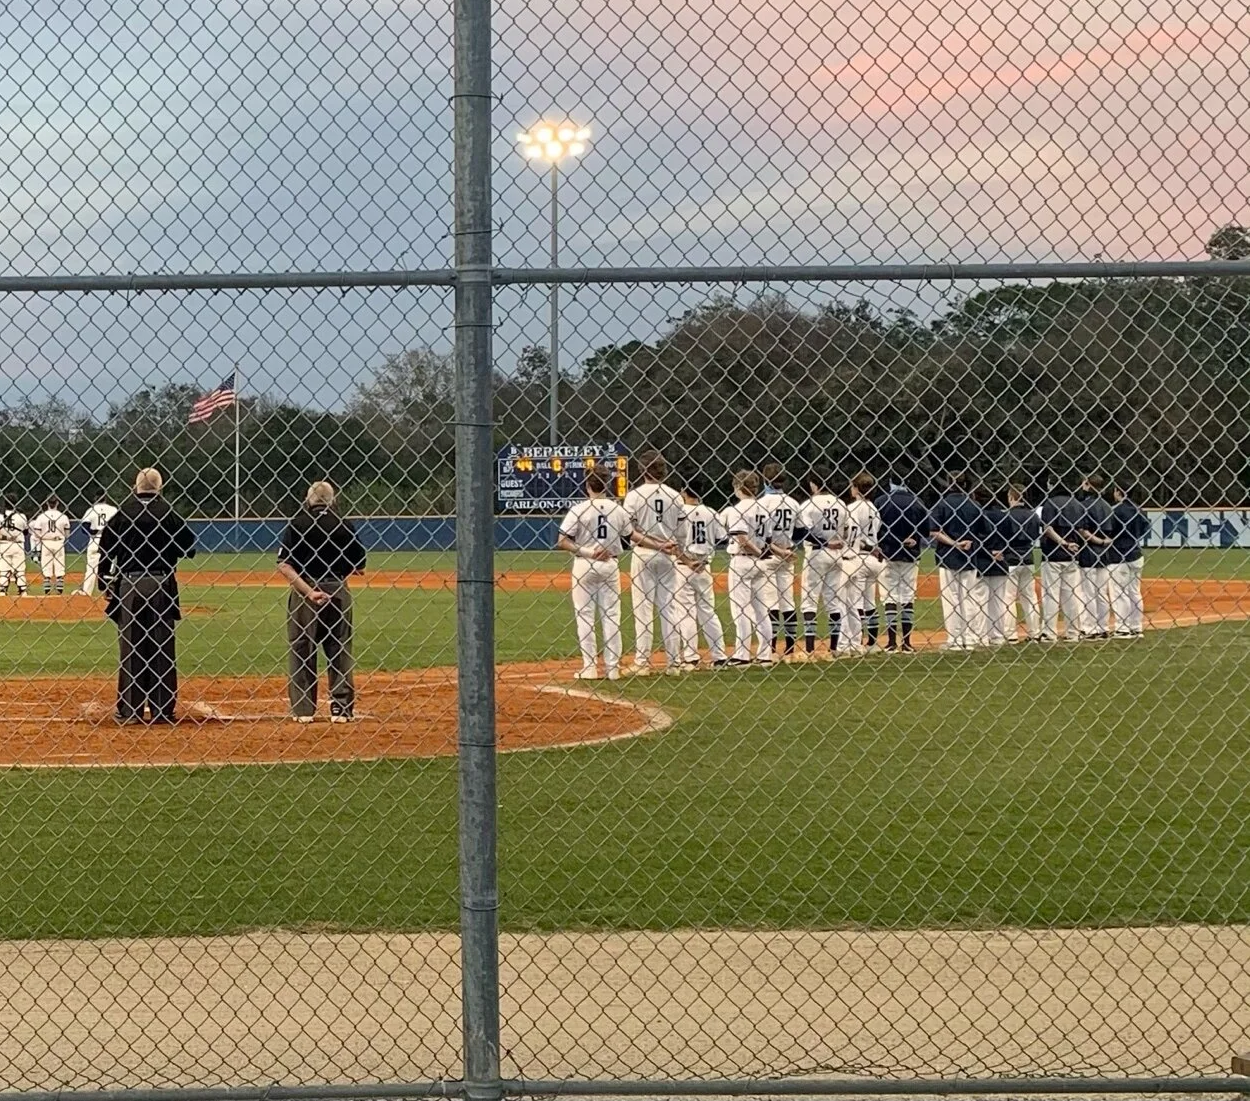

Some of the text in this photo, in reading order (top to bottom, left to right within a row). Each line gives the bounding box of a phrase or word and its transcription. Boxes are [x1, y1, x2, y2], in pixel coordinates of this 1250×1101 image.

[523, 446, 603, 457] BERKELEY
[500, 480, 523, 488] GUEST
[98, 513, 107, 526] 13
[654, 499, 664, 522] 9
[773, 508, 793, 531] 26
[822, 508, 839, 531] 33
[597, 515, 607, 539] 6
[692, 521, 706, 544] 16
[1139, 510, 1250, 548] LEY
